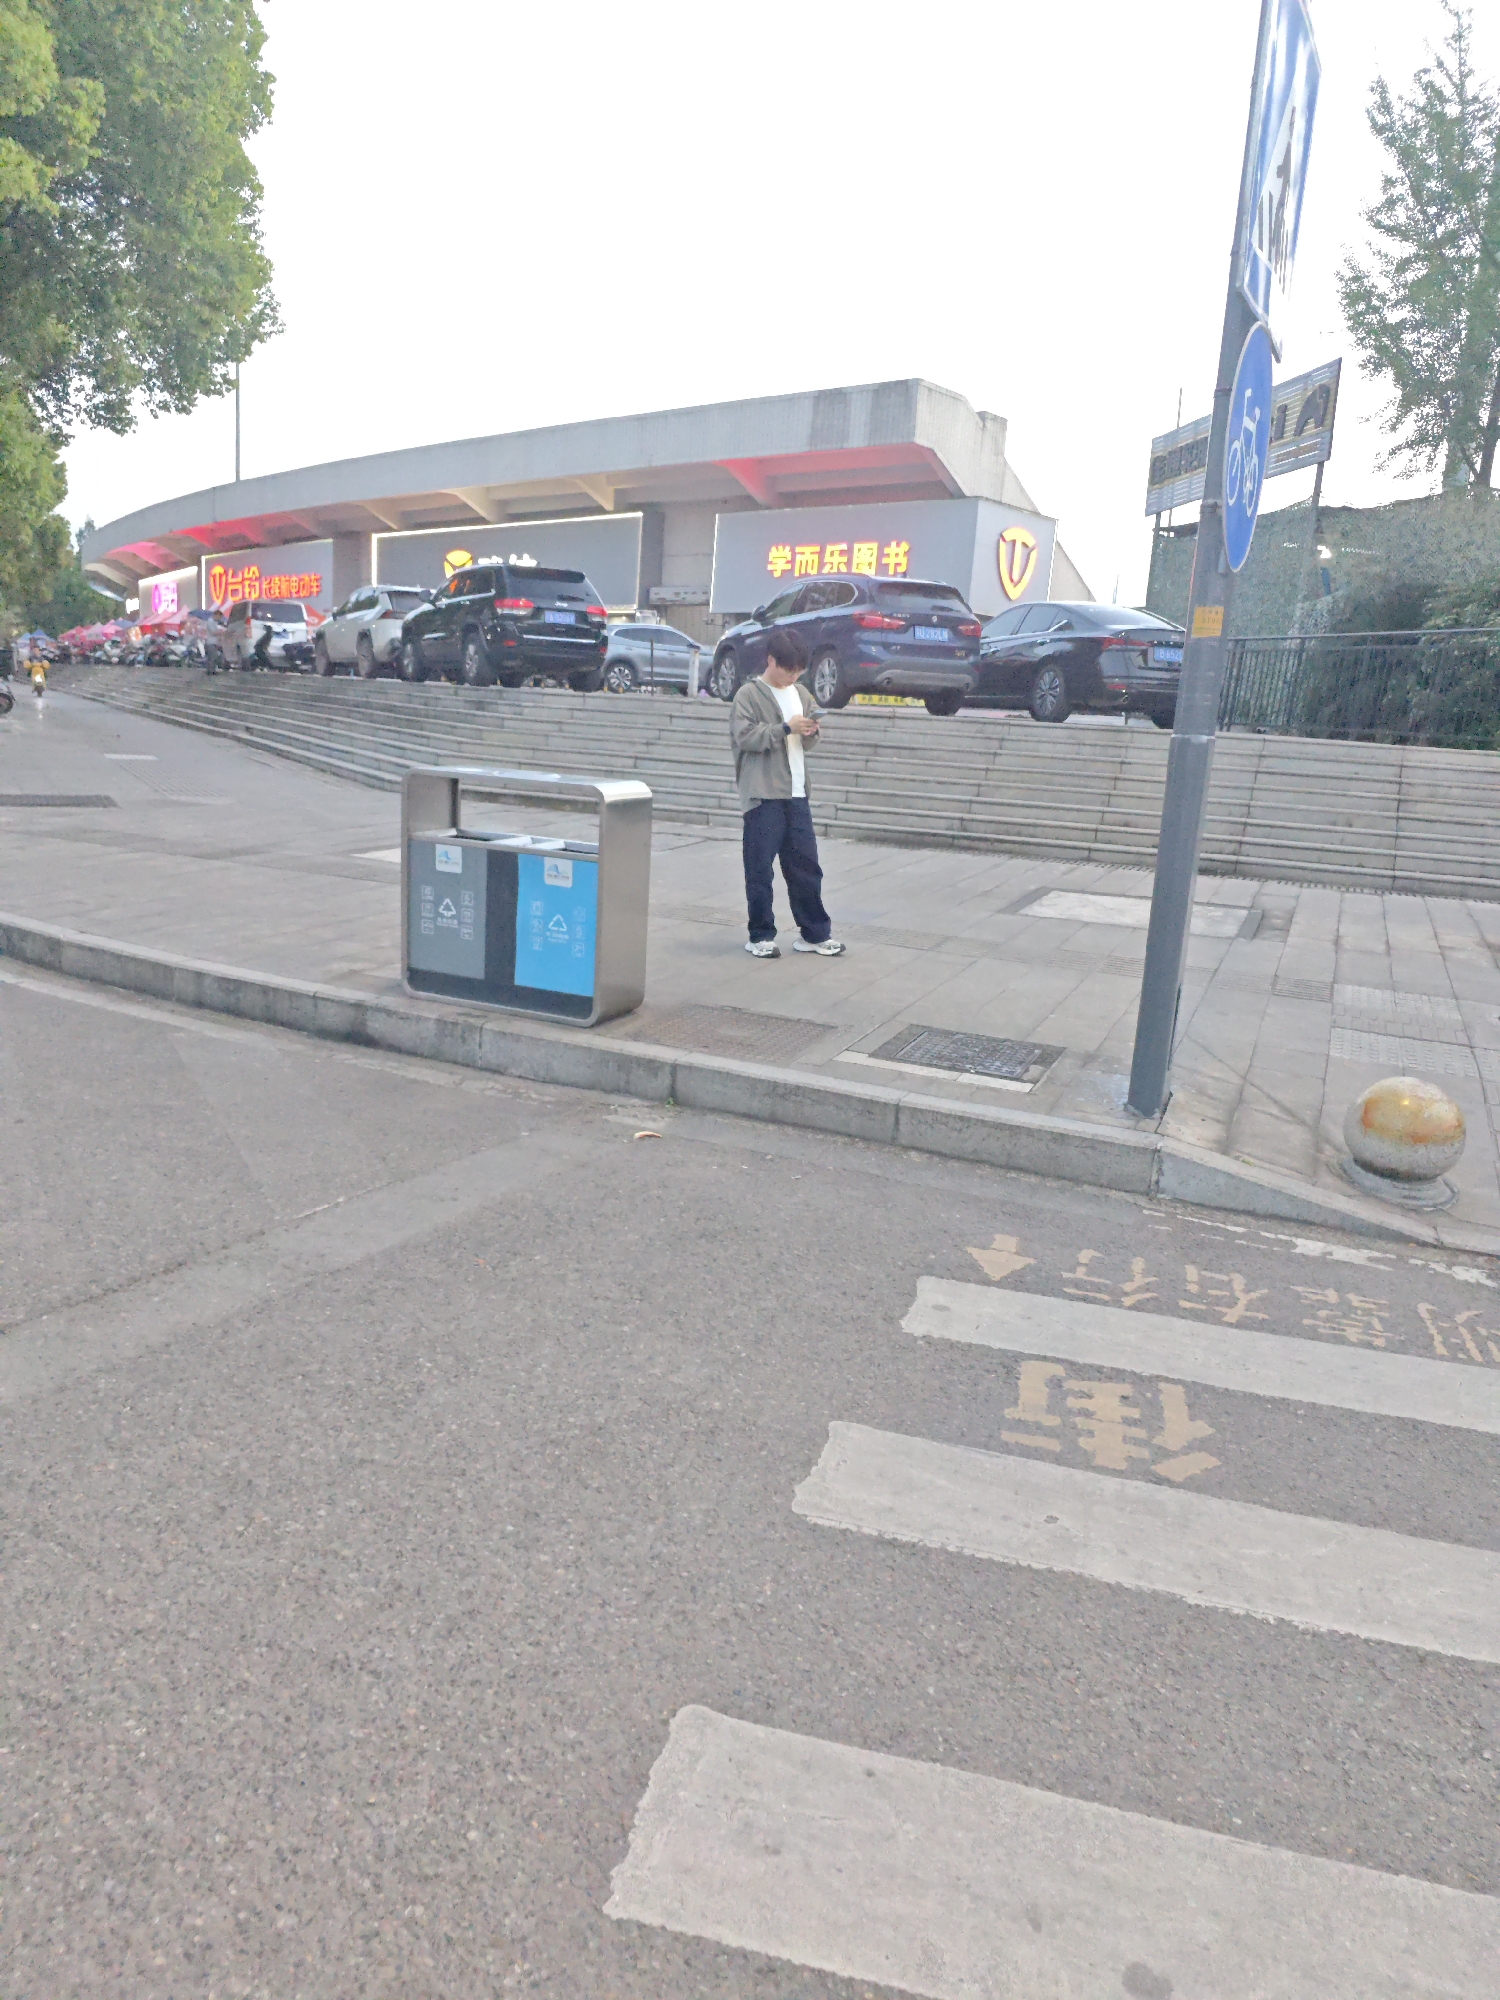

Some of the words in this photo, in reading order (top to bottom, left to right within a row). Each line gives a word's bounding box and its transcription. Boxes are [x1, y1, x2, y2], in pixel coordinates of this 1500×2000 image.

[767, 540, 910, 577] 学而乐图书
[227, 566, 260, 601] 台铃
[1000, 1360, 1222, 1482] 街
